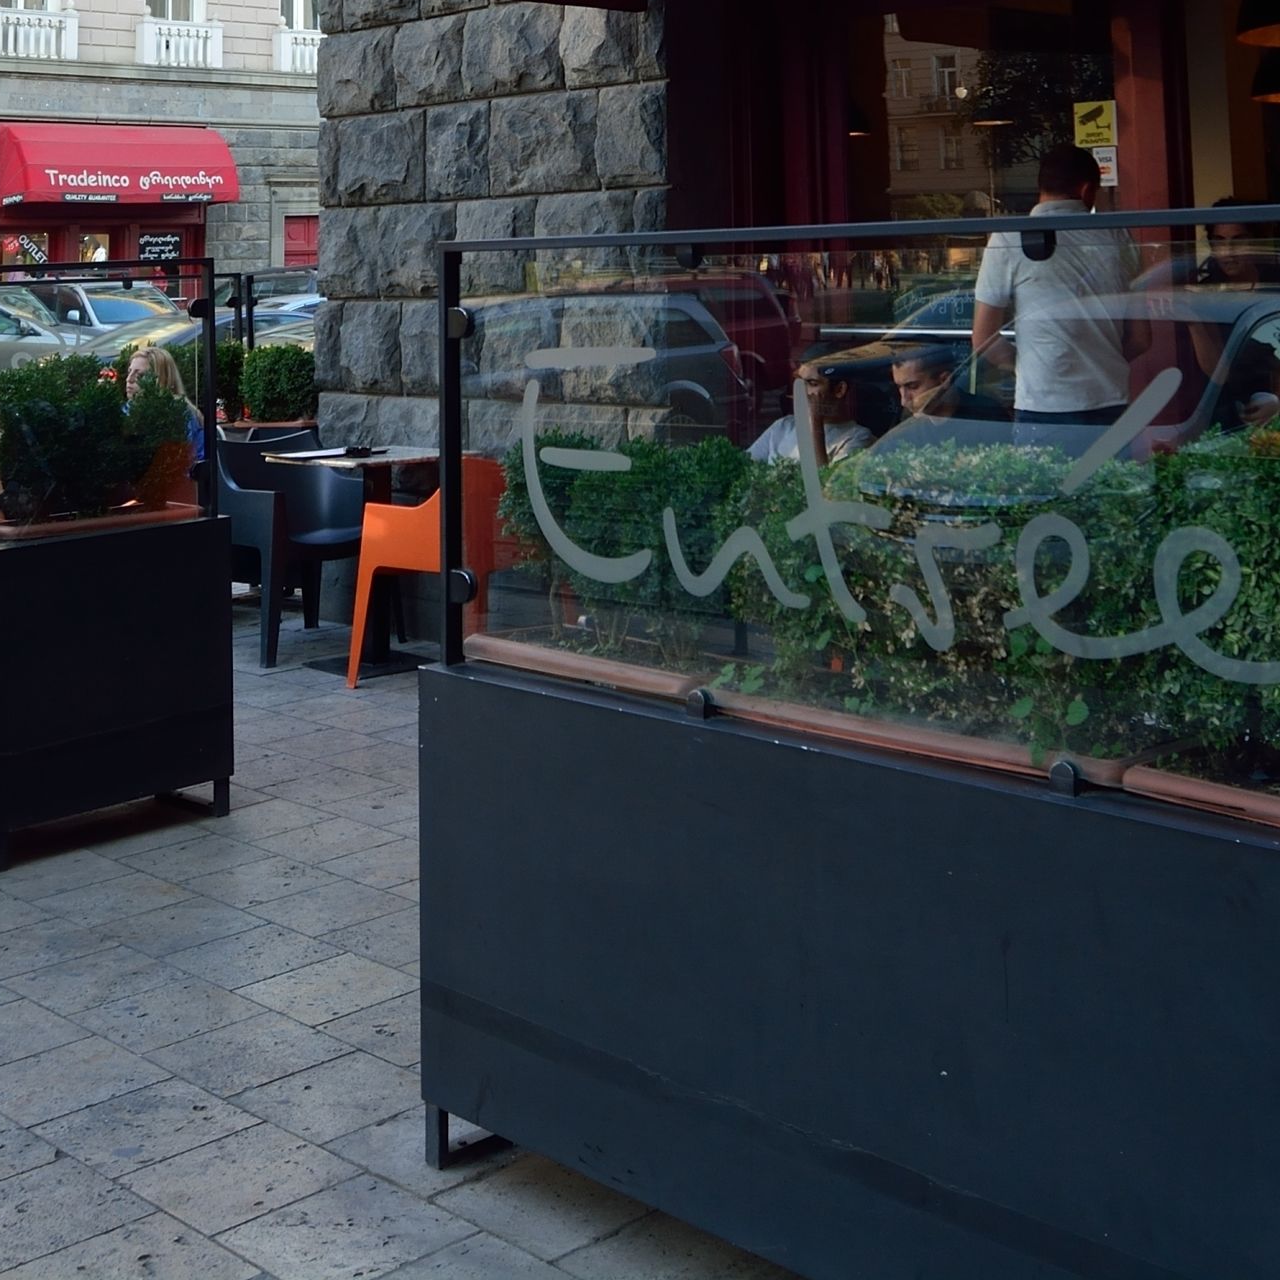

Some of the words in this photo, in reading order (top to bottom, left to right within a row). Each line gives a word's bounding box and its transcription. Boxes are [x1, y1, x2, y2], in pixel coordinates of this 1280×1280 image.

[44, 169, 129, 188] Tradeinco
[139, 170, 224, 191] ტრეიდინკო
[18, 234, 48, 264] OUTLET
